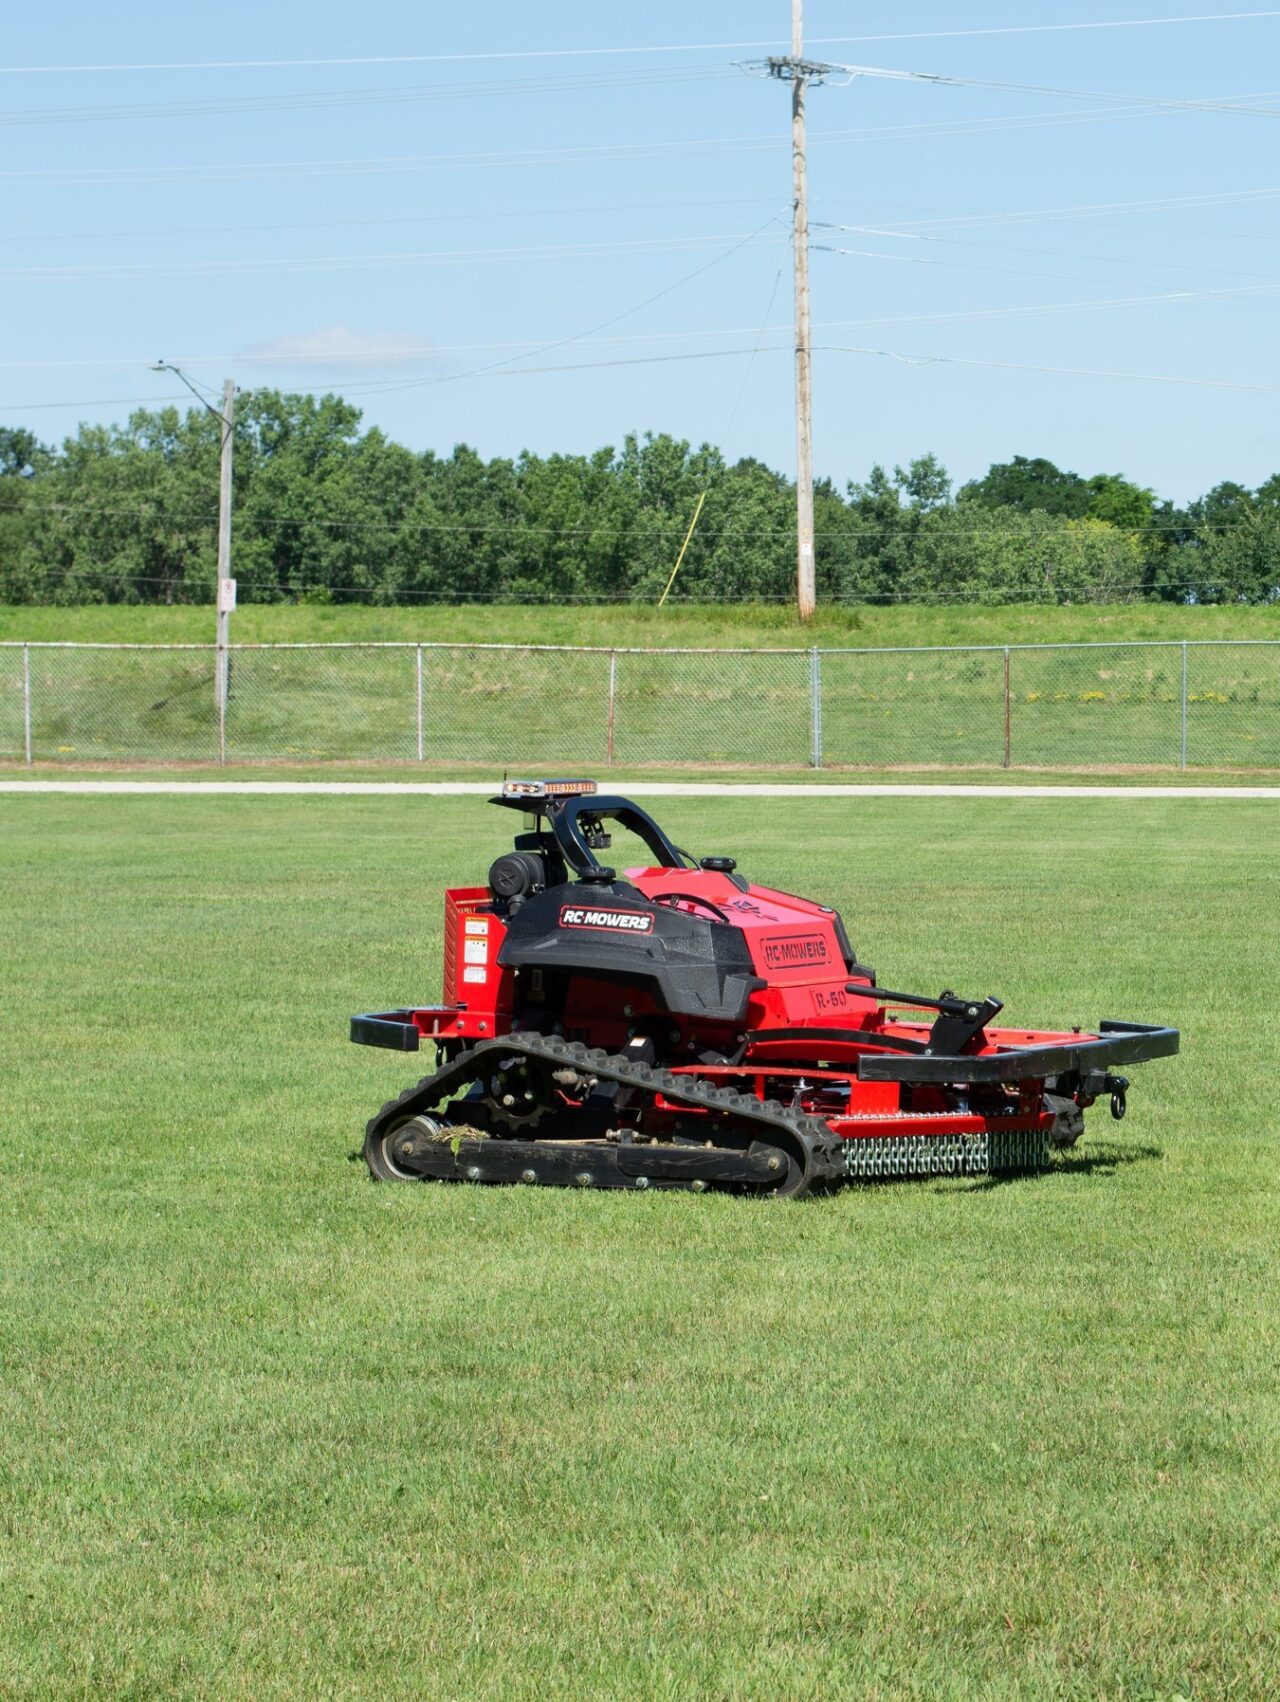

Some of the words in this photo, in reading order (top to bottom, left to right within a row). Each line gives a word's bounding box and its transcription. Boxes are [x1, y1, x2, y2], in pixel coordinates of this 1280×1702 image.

[563, 910, 584, 924] RC
[584, 912, 650, 930] MOWERS
[765, 945, 781, 961] RC
[781, 941, 826, 960] MOWERS
